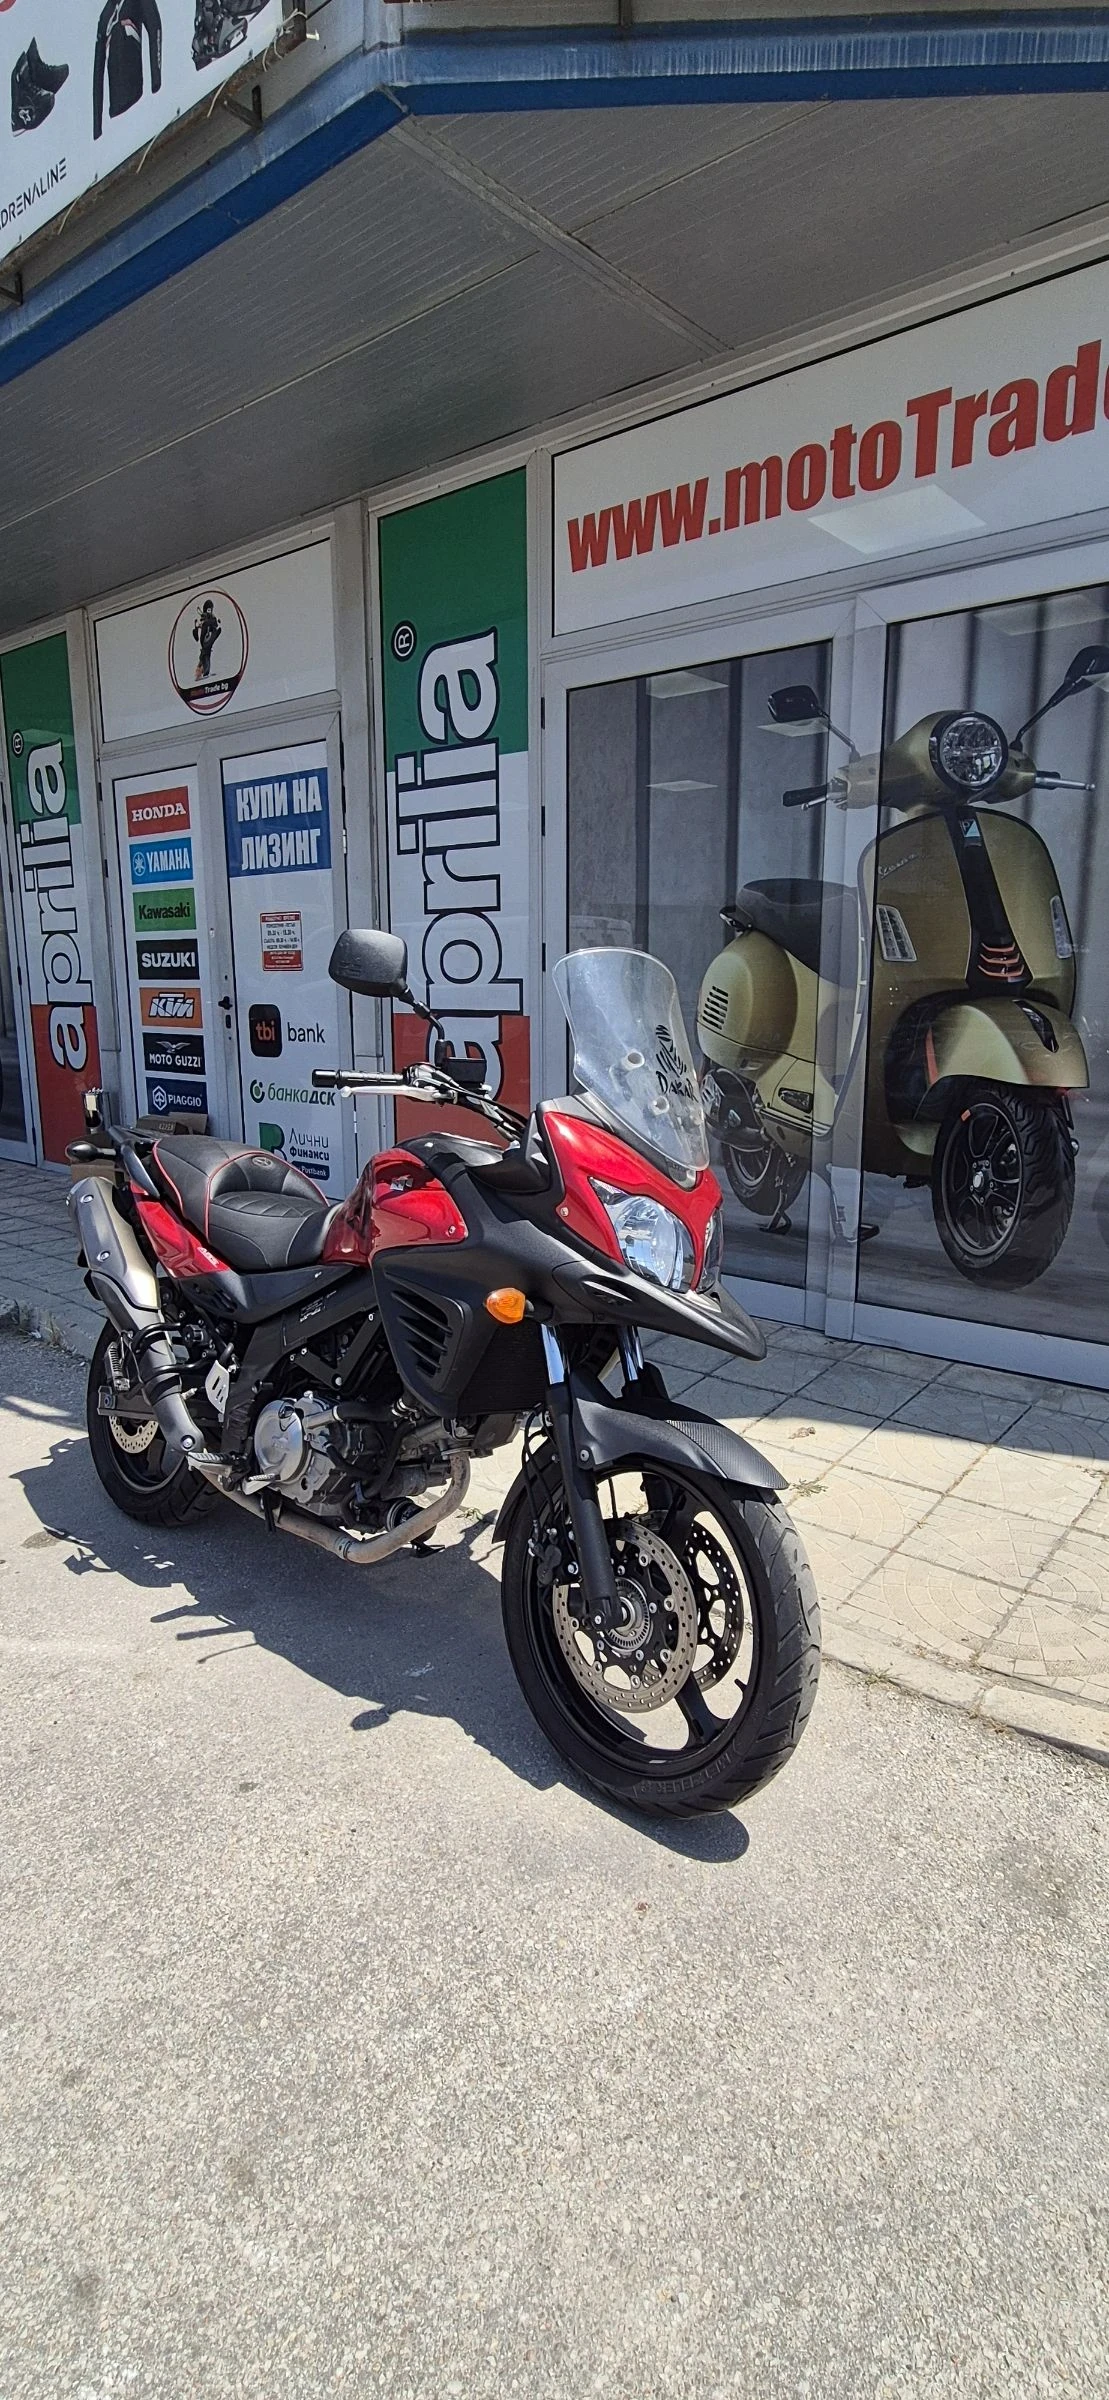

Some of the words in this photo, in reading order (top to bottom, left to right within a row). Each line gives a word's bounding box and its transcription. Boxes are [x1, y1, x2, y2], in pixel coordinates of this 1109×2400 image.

[0, 157, 67, 230] DRENALINE
[567, 339, 1109, 573] www.motoTrad
[236, 781, 288, 822] КУПИ
[292, 776, 322, 814] НА
[132, 802, 187, 822] HONDA
[147, 847, 191, 873] YAMAHA
[241, 828, 321, 871] ЛИЗИНГ
[20, 738, 95, 1073] aprilia
[139, 902, 191, 920] Kawasaki
[141, 952, 196, 968] SUZUKI
[149, 992, 195, 1019] KTM
[255, 1020, 275, 1041] tbi
[287, 1022, 326, 1044] bank
[149, 1053, 172, 1066] MOTO
[175, 1055, 201, 1068] GUZZI
[167, 1094, 202, 1107] PIAGGIO
[289, 1127, 329, 1148] Лични
[289, 1146, 330, 1161] Финанси
[301, 1165, 327, 1177] Postbank
